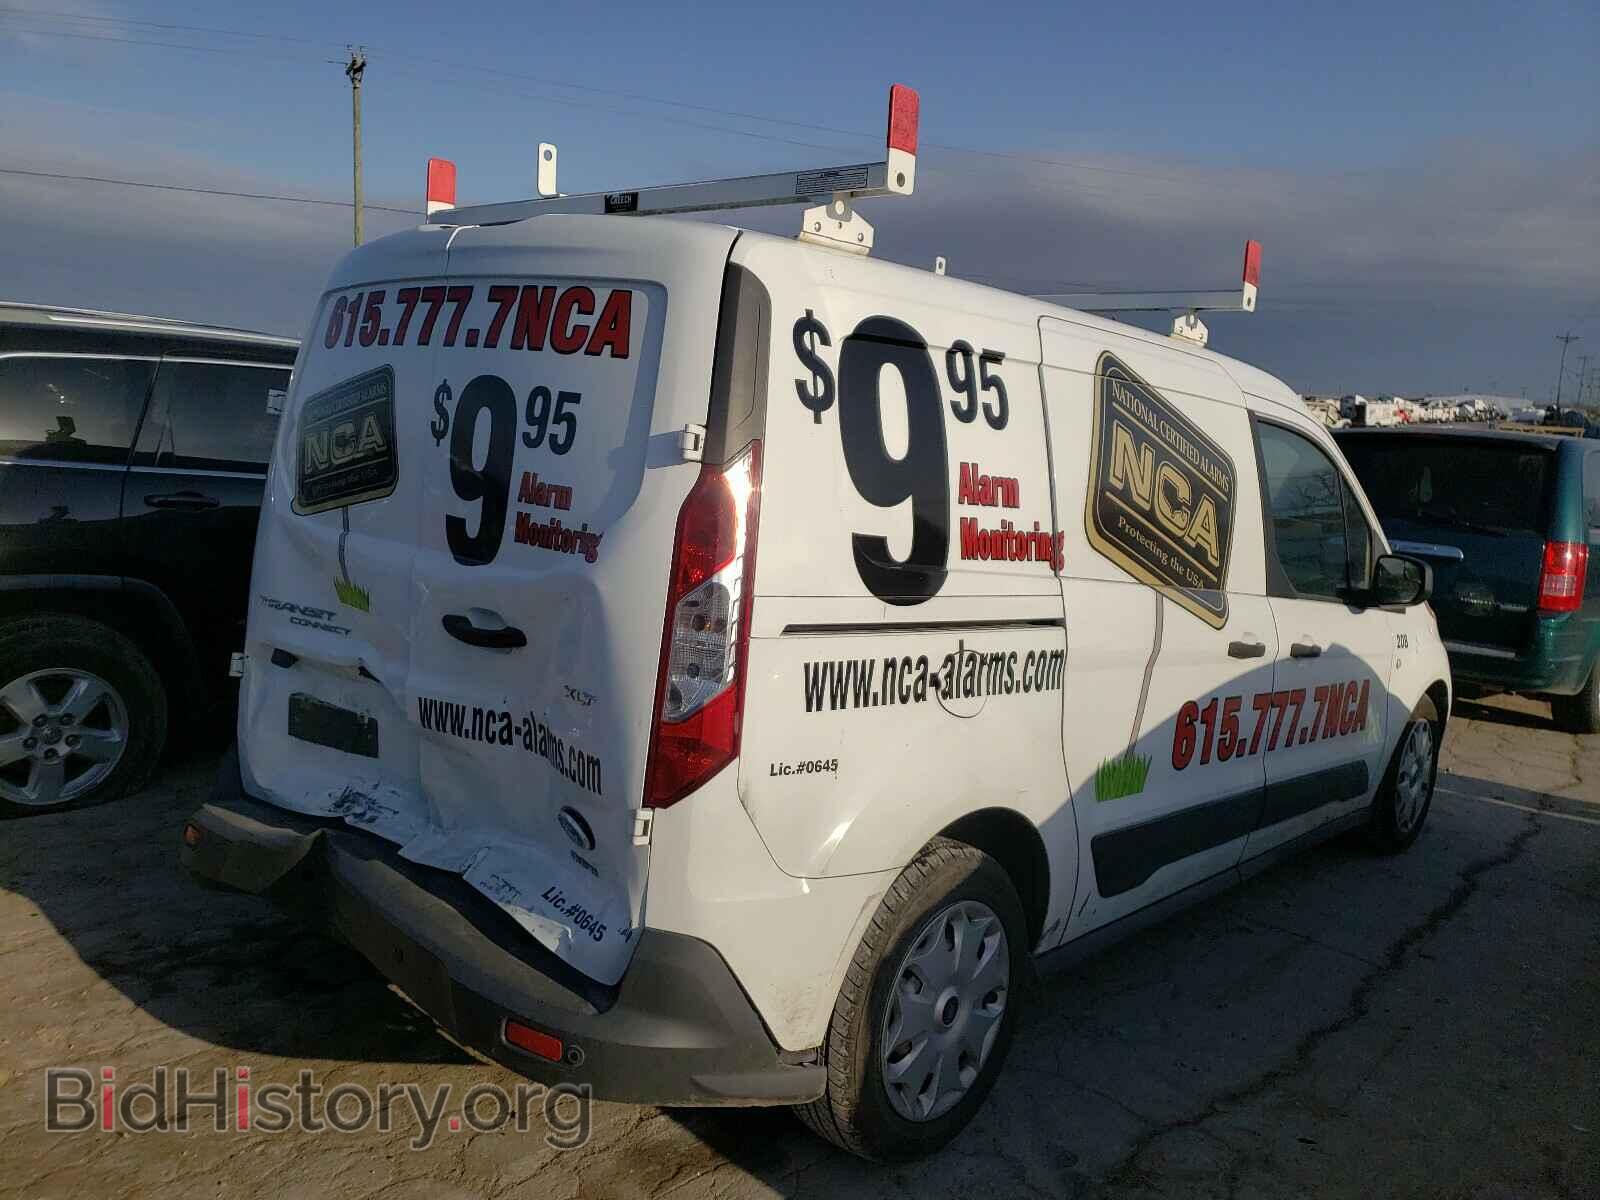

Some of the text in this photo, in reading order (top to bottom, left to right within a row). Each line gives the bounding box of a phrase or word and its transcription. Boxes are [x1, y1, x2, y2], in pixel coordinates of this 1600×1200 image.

[323, 285, 633, 360] 615.777.7NCA
[946, 339, 1010, 431] 95
[304, 412, 388, 475] NCA
[522, 385, 582, 455] 95
[1112, 380, 1229, 492] NATIONAL CERTIFIED ALARMS
[518, 472, 573, 511] Alarm
[958, 462, 1020, 509] Alarm
[1109, 419, 1220, 568] NCA
[514, 512, 604, 563] Monitoring
[960, 517, 1065, 572] Monitoring
[1118, 516, 1168, 565] Protecting
[1170, 557, 1185, 575] the
[804, 639, 1065, 713] www.nca-alarms.com
[1171, 679, 1370, 771] 615.777.7NCA
[769, 758, 839, 777] Lic.#0645
